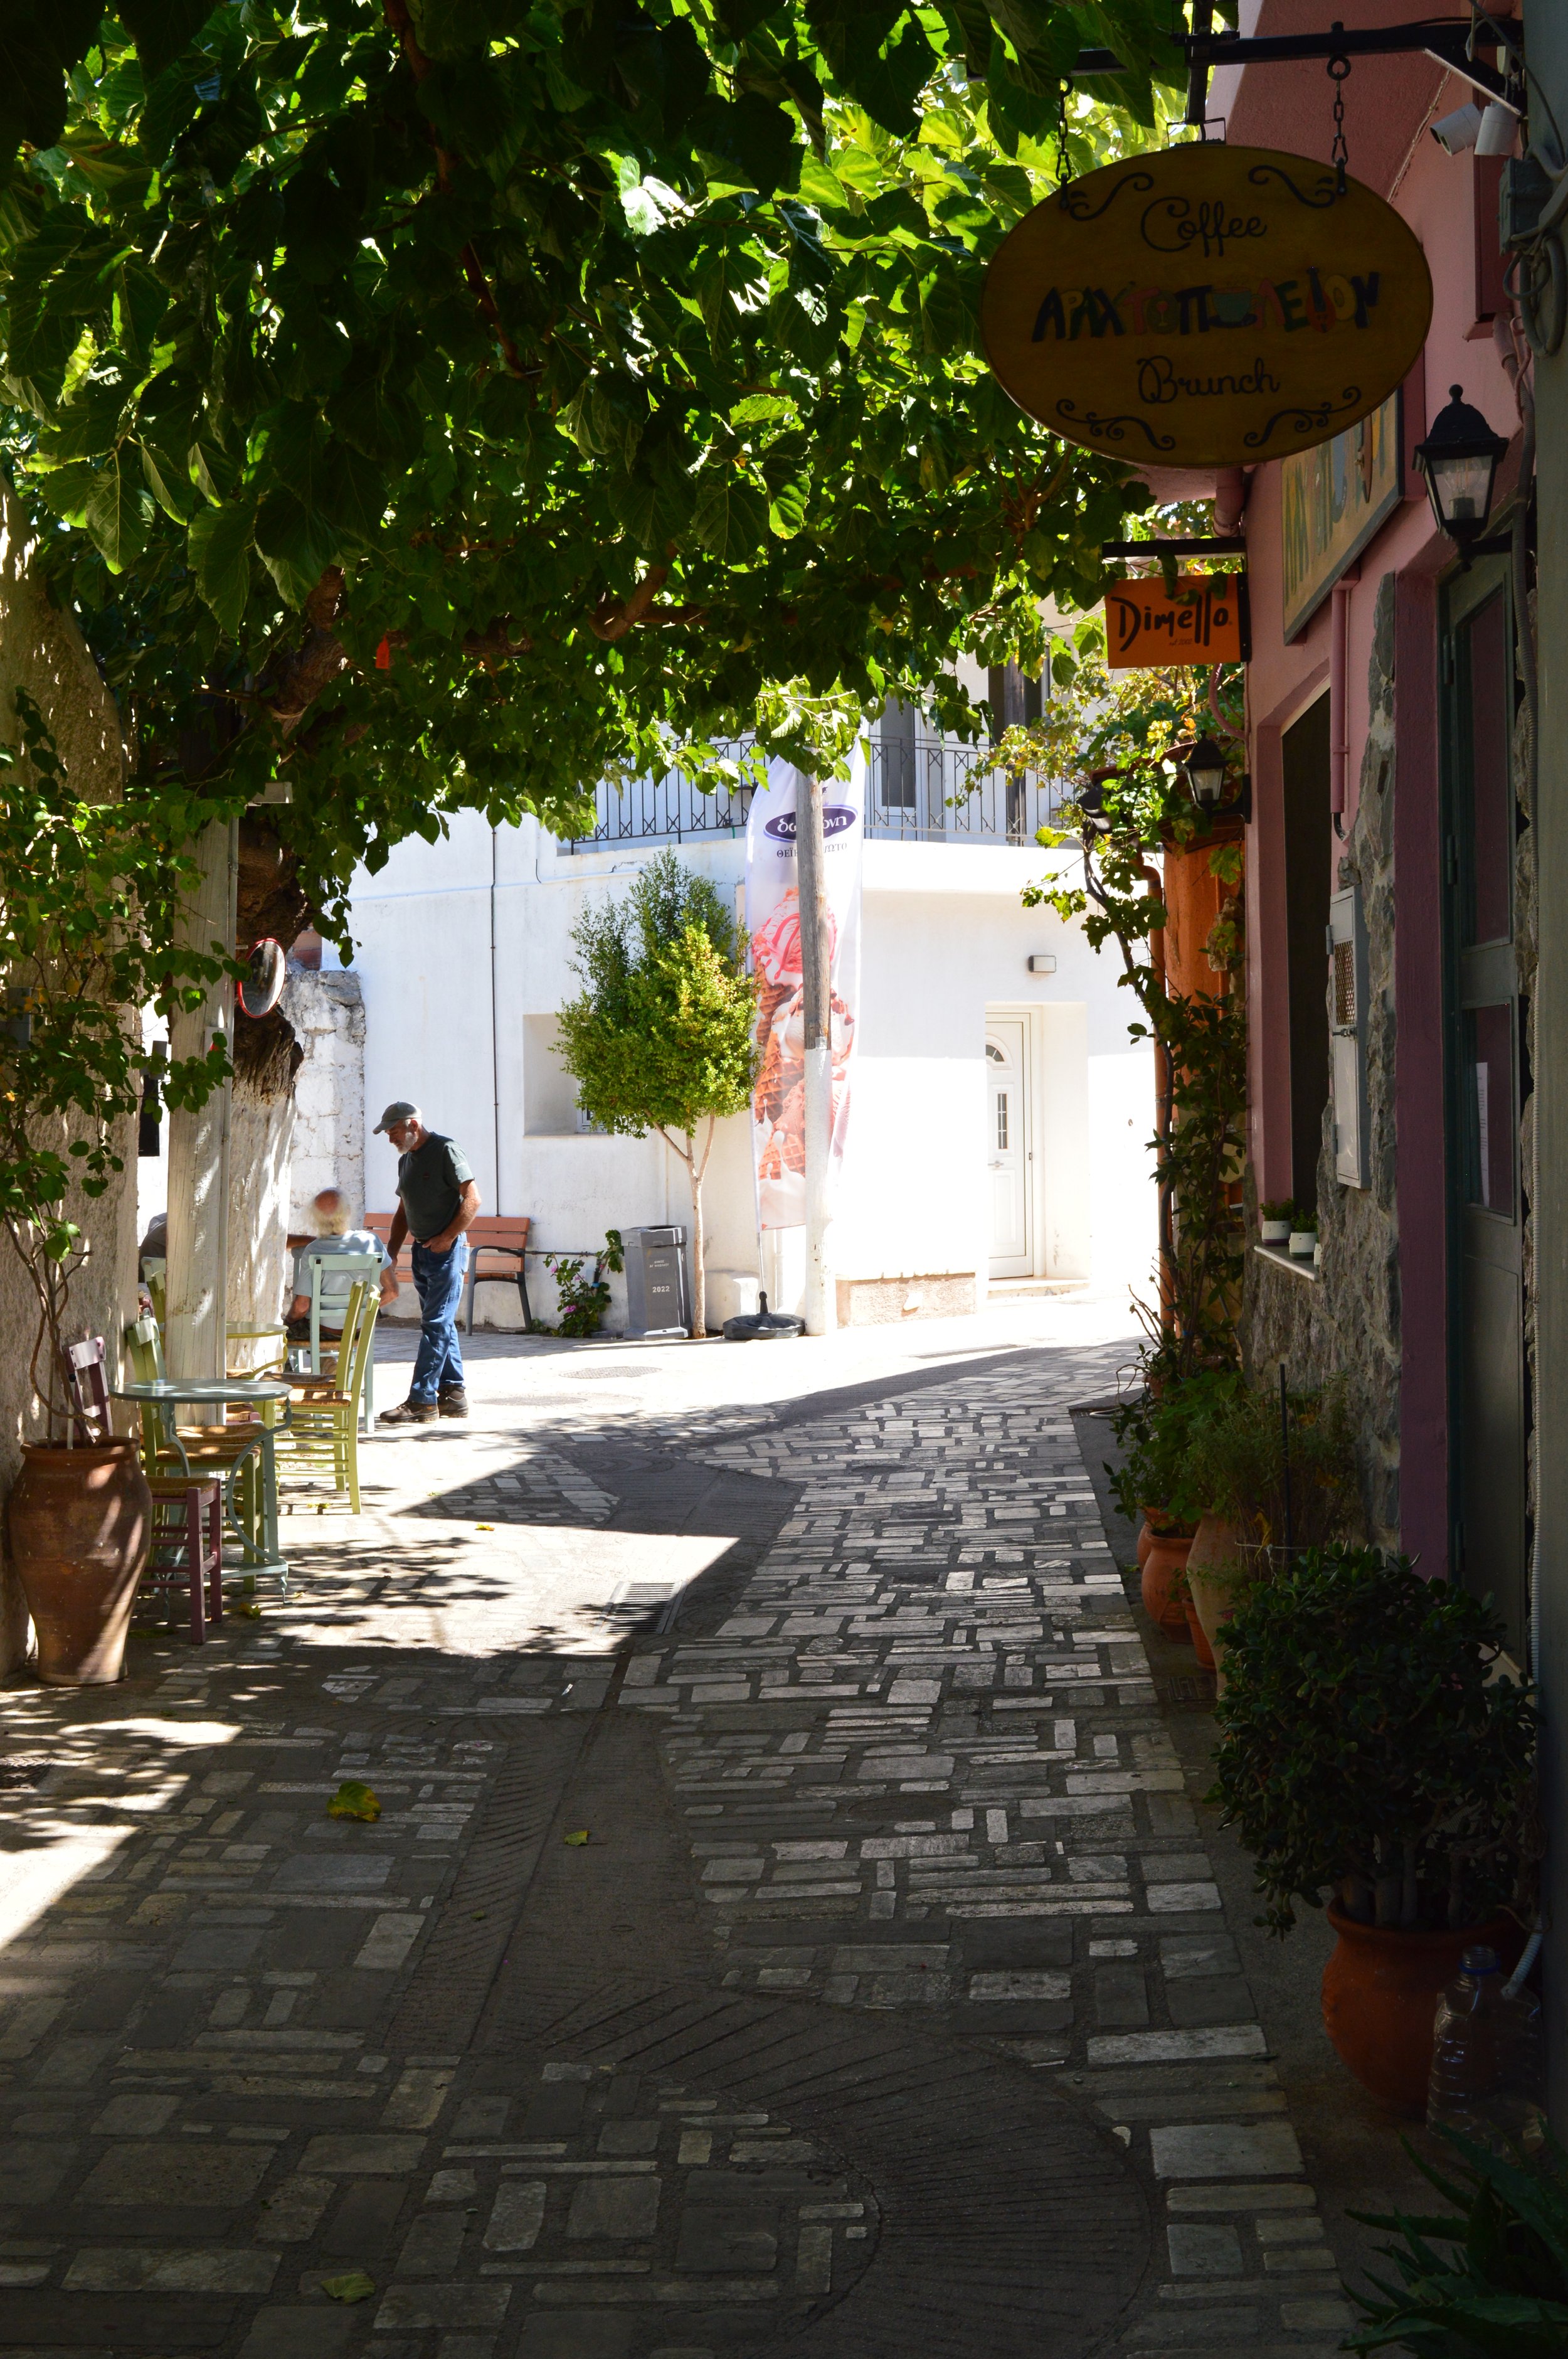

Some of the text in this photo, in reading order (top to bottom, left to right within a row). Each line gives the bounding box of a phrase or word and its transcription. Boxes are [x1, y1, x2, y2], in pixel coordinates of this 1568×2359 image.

[1140, 196, 1268, 258] Coffee
[1136, 355, 1281, 404] Brunch
[1110, 592, 1229, 652] Dimello
